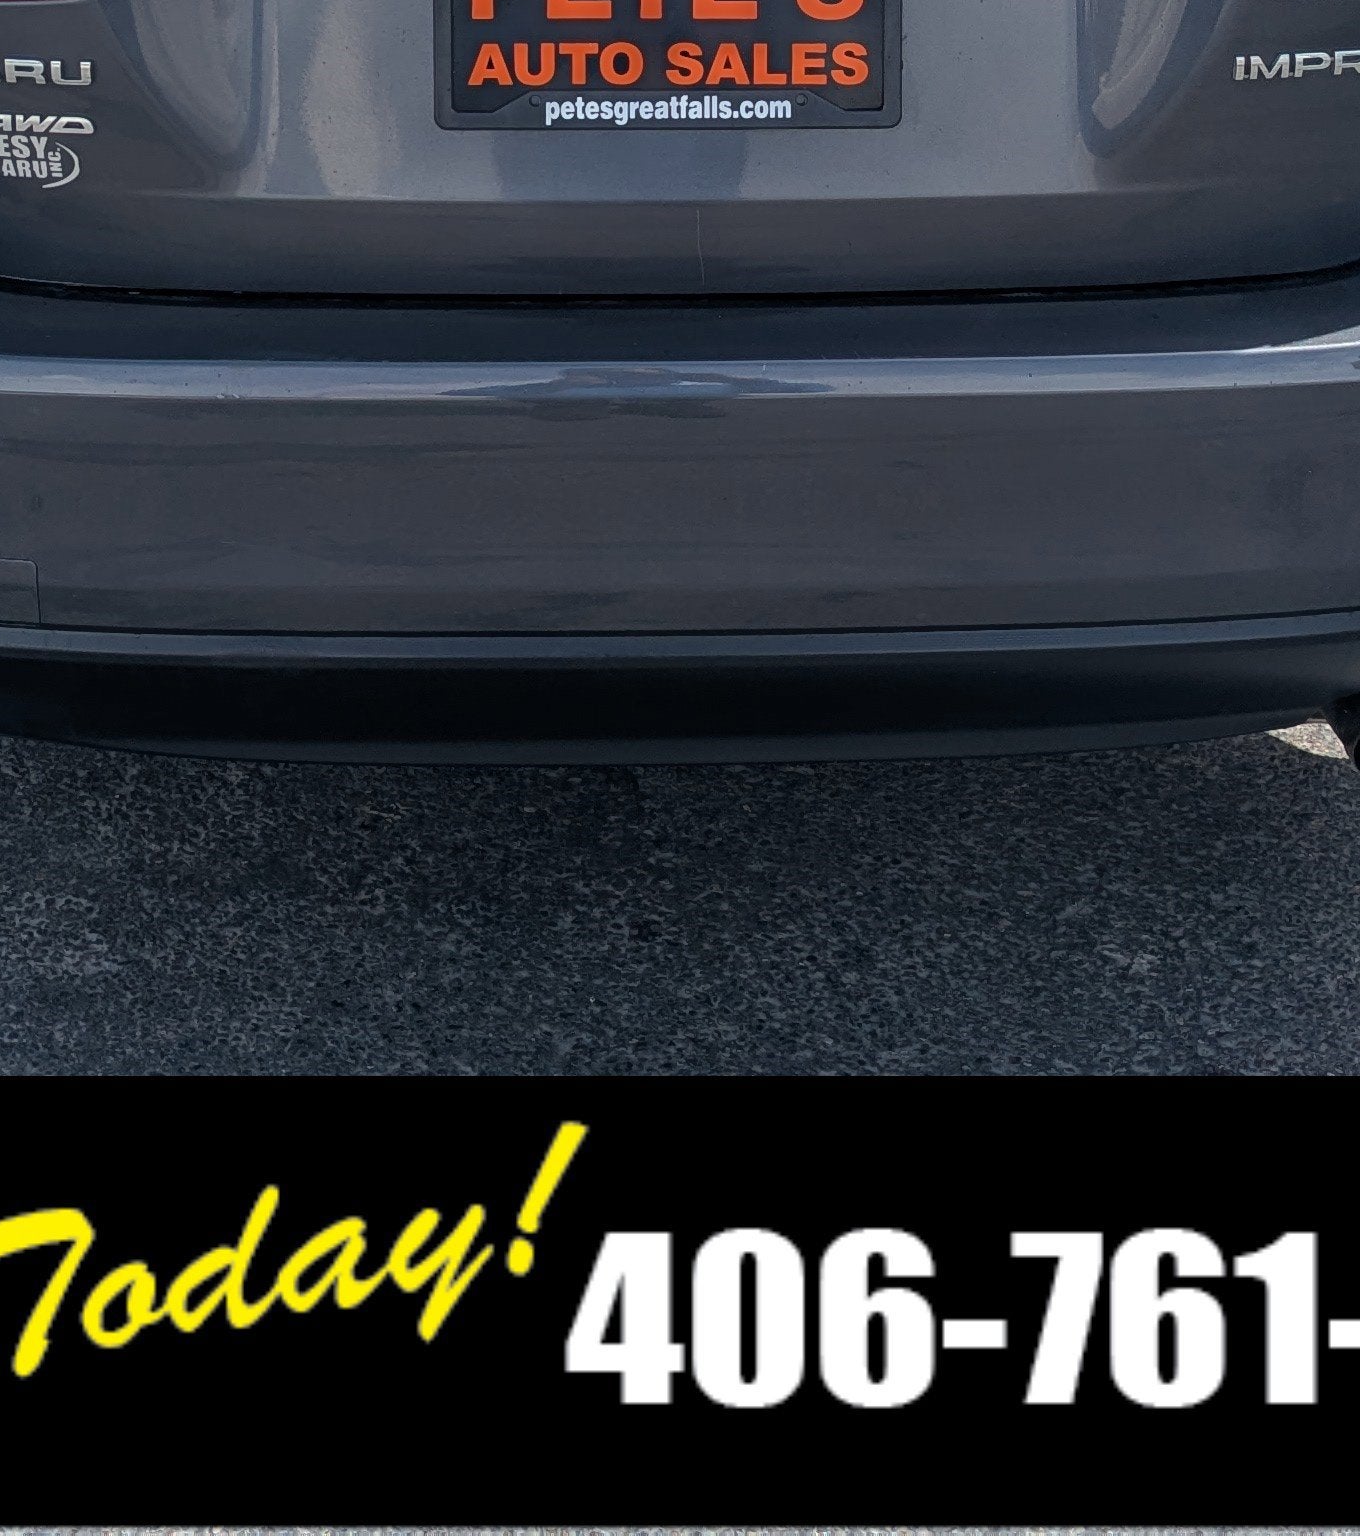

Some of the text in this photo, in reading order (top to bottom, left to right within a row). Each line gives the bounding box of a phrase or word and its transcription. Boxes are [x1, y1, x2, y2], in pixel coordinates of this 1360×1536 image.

[468, 42, 869, 86] AUTO SALES
[544, 94, 792, 126] petesgreatfalls.com
[49, 147, 63, 178] INC.
